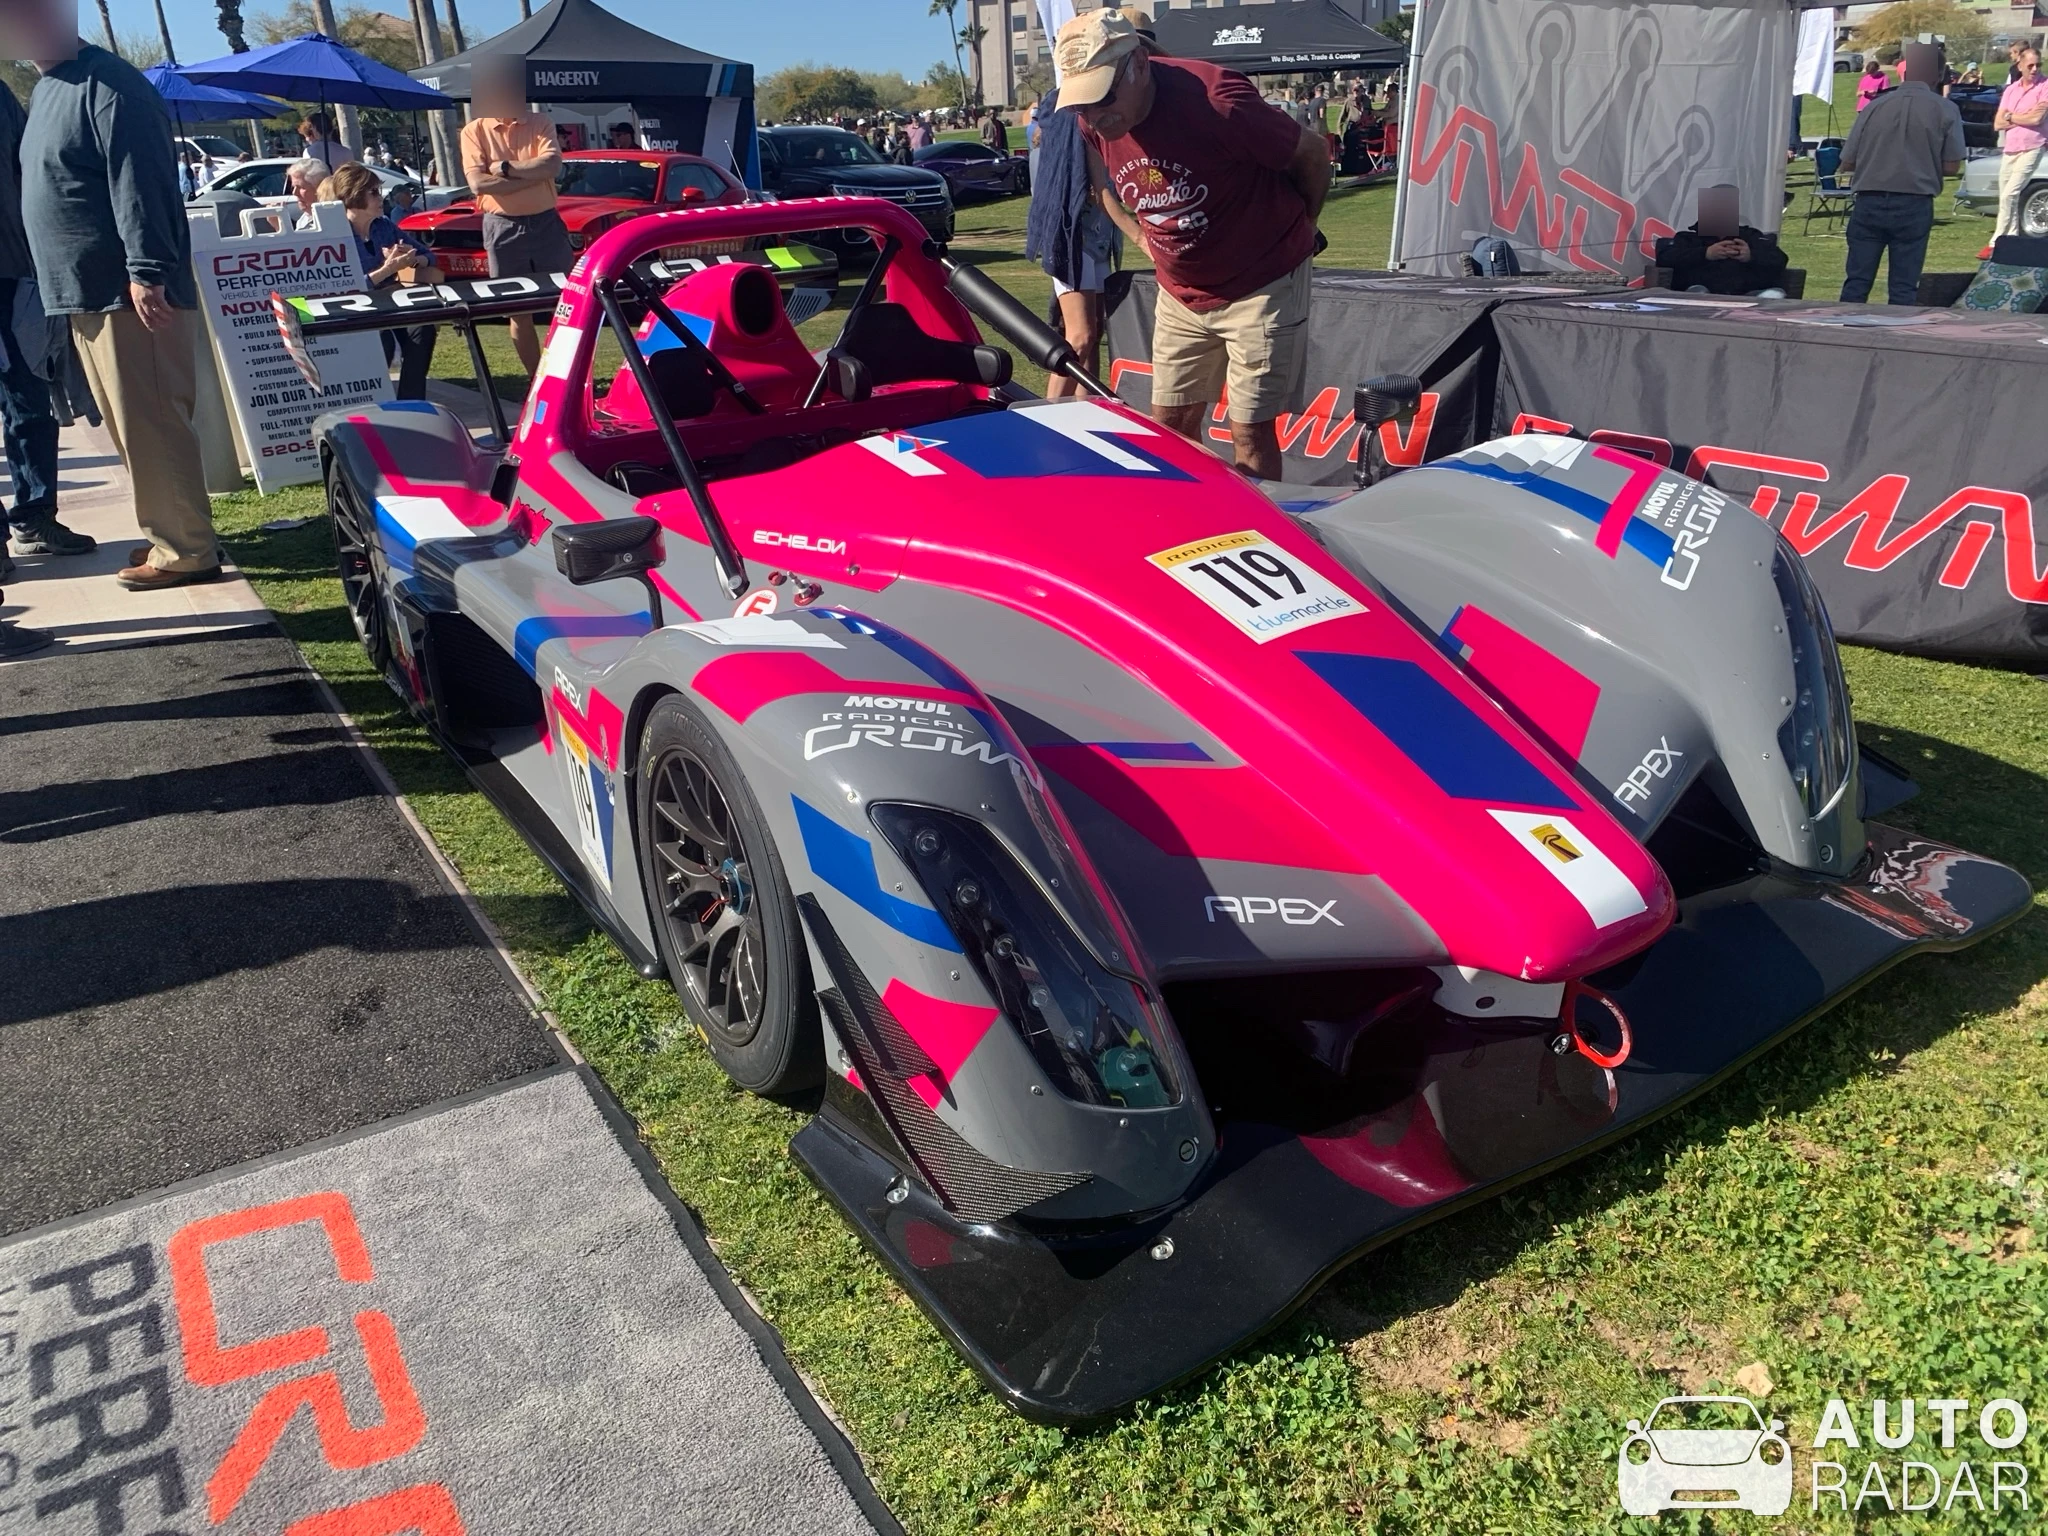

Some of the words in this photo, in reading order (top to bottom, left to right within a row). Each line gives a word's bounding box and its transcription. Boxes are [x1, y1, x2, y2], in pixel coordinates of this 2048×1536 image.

[1282, 55, 1295, 63] Buy,
[1296, 54, 1310, 62] Sell,
[1310, 53, 1328, 61] Trade
[535, 71, 599, 86] HAGERTY
[641, 133, 679, 153] Never
[1116, 158, 1192, 184] CHEVROLET
[1120, 177, 1208, 214] Corvette
[213, 244, 347, 276] CROWN
[216, 265, 353, 291] PERFORMANCE
[221, 289, 259, 300] VEHICLE
[262, 282, 327, 298] DEVELOPMENT
[331, 279, 356, 288] TEAM
[221, 300, 276, 317] NOW
[232, 313, 277, 328] EXPERIEN
[244, 330, 265, 340] BUILD
[248, 341, 285, 353] TRACK-SID
[312, 347, 339, 358] COBRAS
[255, 366, 298, 379] RESTOMODS
[250, 393, 279, 408] JOIN
[282, 389, 307, 404] OUR
[346, 378, 383, 394] TODAY
[258, 380, 288, 392] CUSTOM
[267, 405, 312, 417] COMPETITIVE
[313, 402, 327, 412] PAY
[328, 400, 342, 409] AND
[344, 395, 374, 406] BENEFITS
[260, 417, 303, 432] FULL-TIME
[1641, 481, 1679, 519] MOTUL
[1664, 481, 1698, 528] RADICAL
[753, 530, 846, 555] ECHELON
[1166, 536, 1257, 562] RADICAL
[1188, 549, 1307, 609] 119
[1247, 595, 1351, 632] bluemarble
[554, 666, 585, 717] APEX
[844, 695, 952, 717] MOTUL
[822, 712, 975, 735] RADICAL
[1613, 735, 1684, 815] APEX
[567, 746, 596, 841] 119
[1203, 896, 1345, 927] APEX
[30, 1243, 192, 1536] PERF
